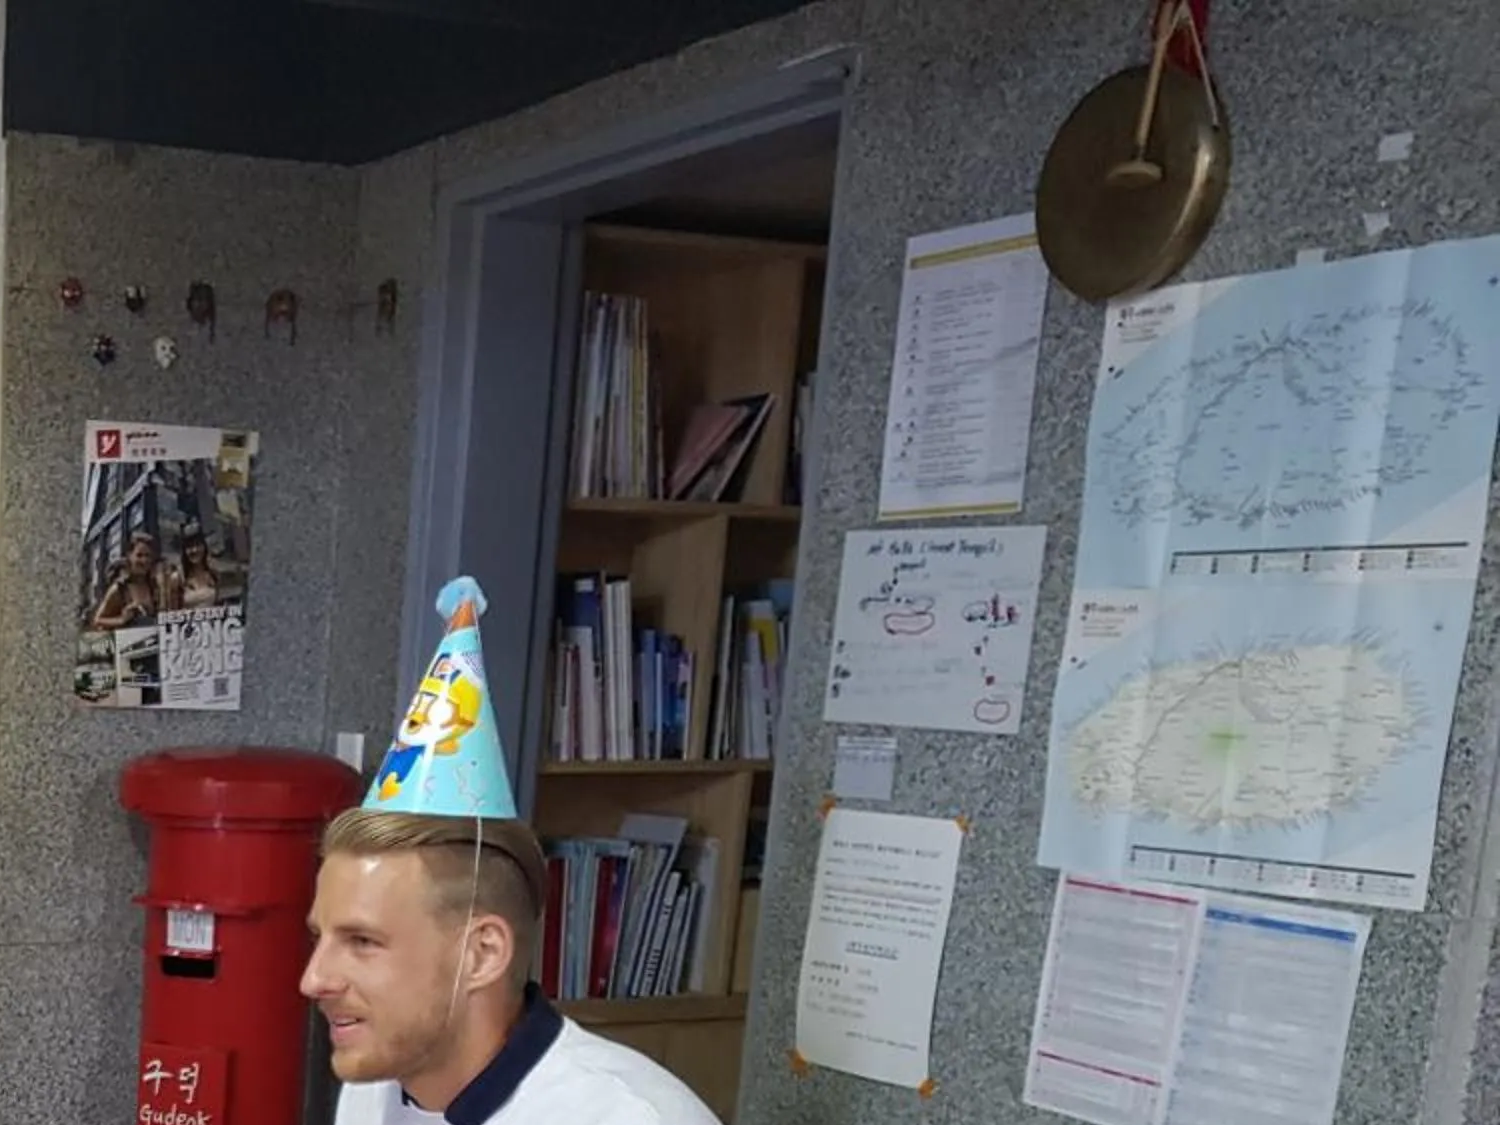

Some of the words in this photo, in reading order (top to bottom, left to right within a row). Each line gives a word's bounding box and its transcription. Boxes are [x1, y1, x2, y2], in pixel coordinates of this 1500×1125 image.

[158, 609, 193, 624] BEST
[194, 605, 226, 620] STAY
[228, 603, 243, 617] IN
[158, 617, 244, 652] HONG
[159, 645, 244, 679] KONG
[142, 1059, 199, 1104] 구덕
